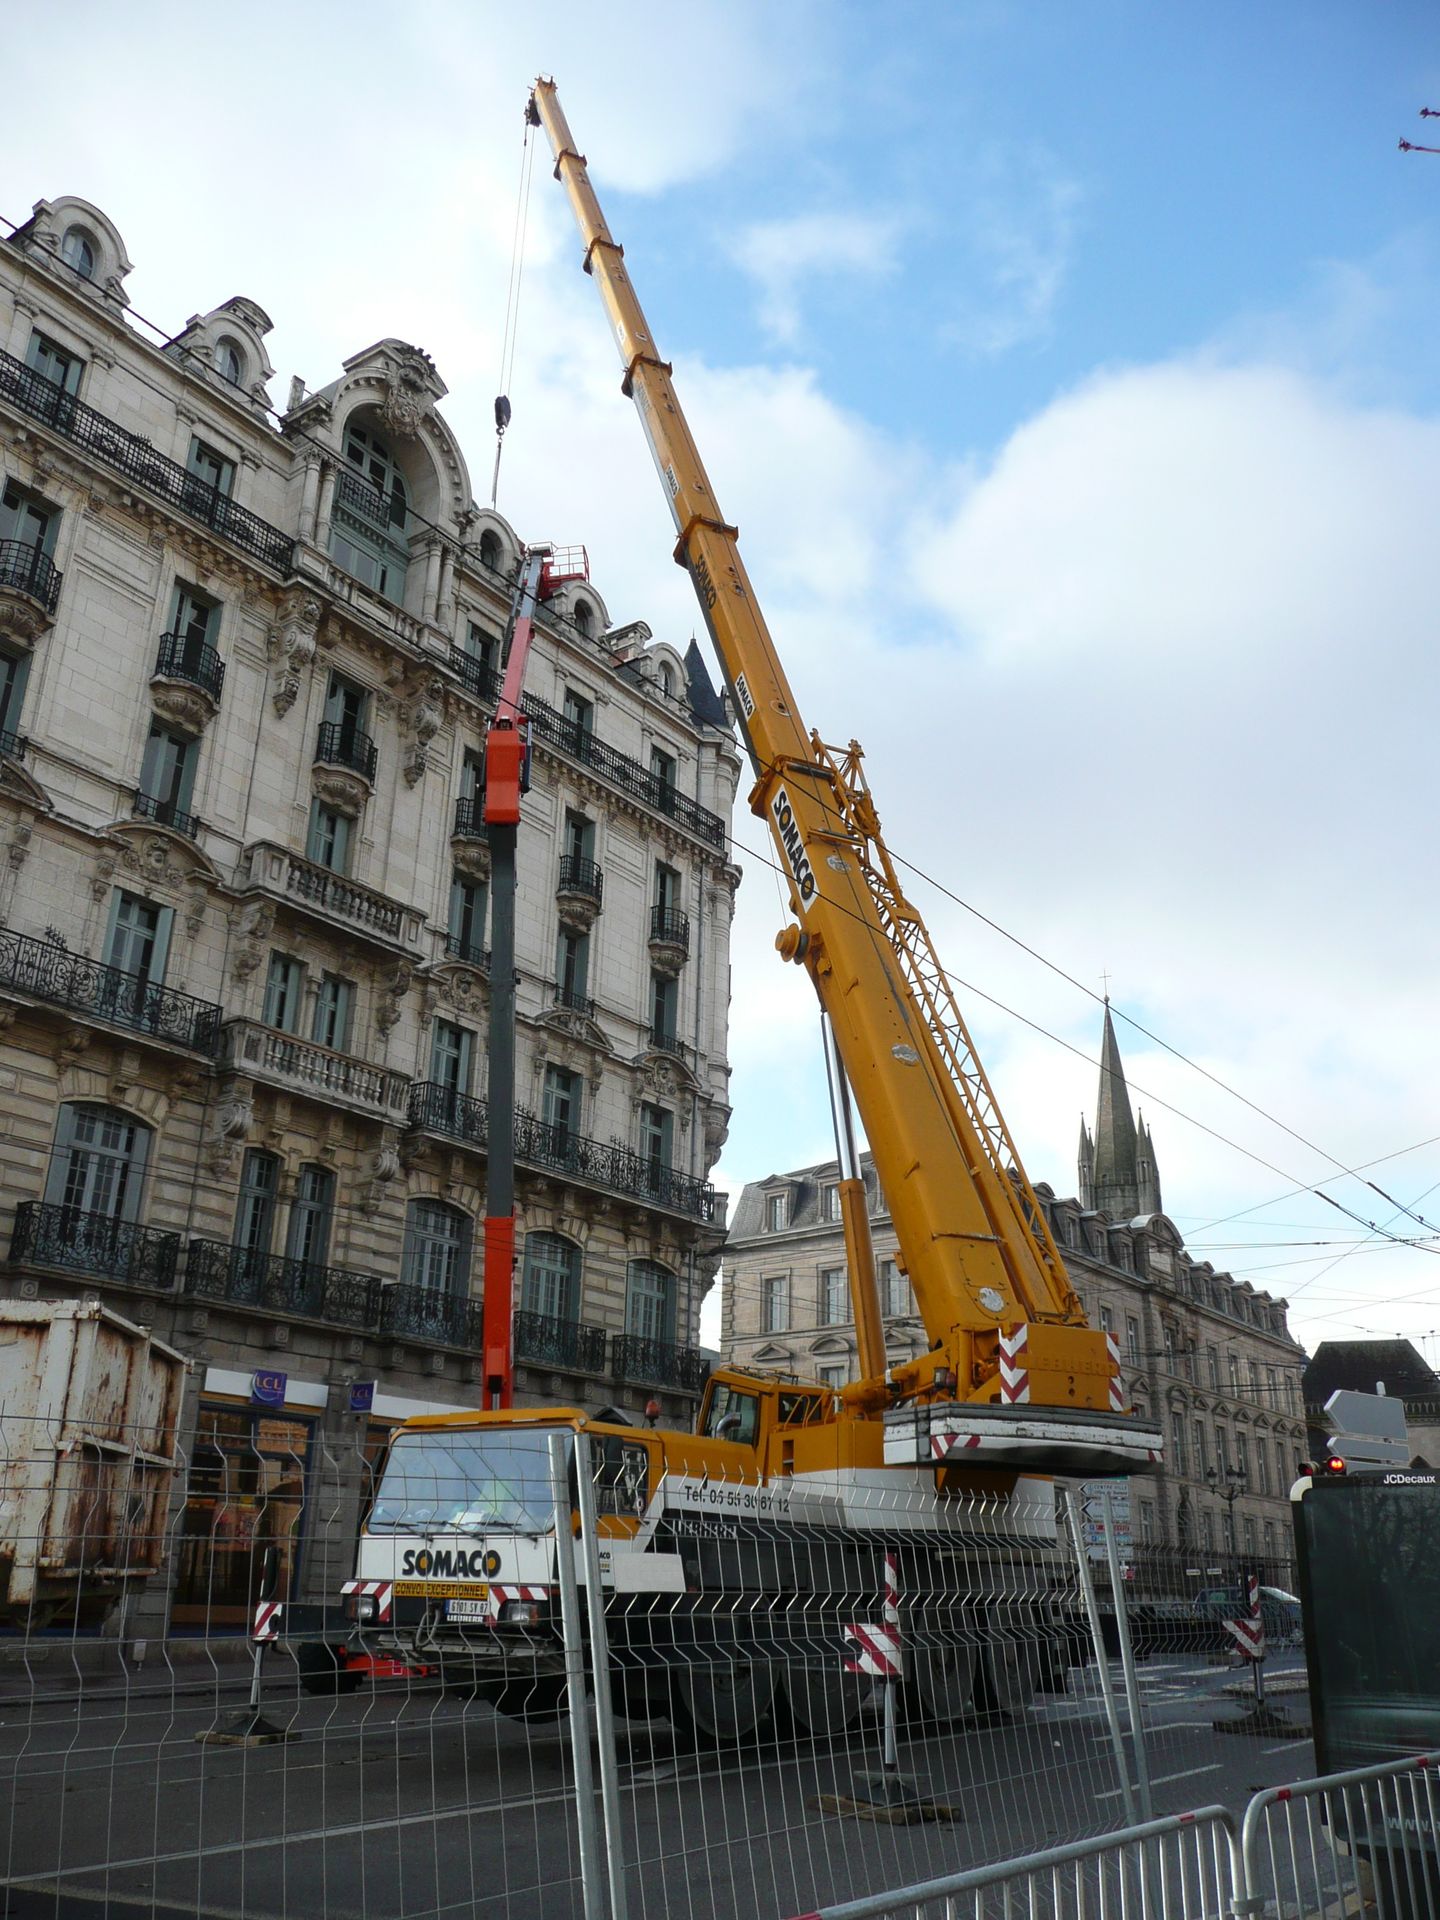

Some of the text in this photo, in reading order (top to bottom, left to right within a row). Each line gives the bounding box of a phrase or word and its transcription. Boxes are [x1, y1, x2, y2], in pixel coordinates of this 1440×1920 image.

[695, 553, 717, 610] SOMACO
[736, 675, 753, 716] SOMACO
[773, 790, 815, 900] SOMACO
[256, 1375, 282, 1390] LCL
[352, 1389, 369, 1398] LCL
[1383, 1474, 1436, 1484] JCDecaux
[684, 1485, 706, 1503] Tél.
[778, 1498, 790, 1513] 12
[402, 1549, 502, 1578] SOMACO
[395, 1582, 485, 1597] CONVOI EXCEPTIONNEL
[446, 1614, 484, 1623] LIEBHERR
